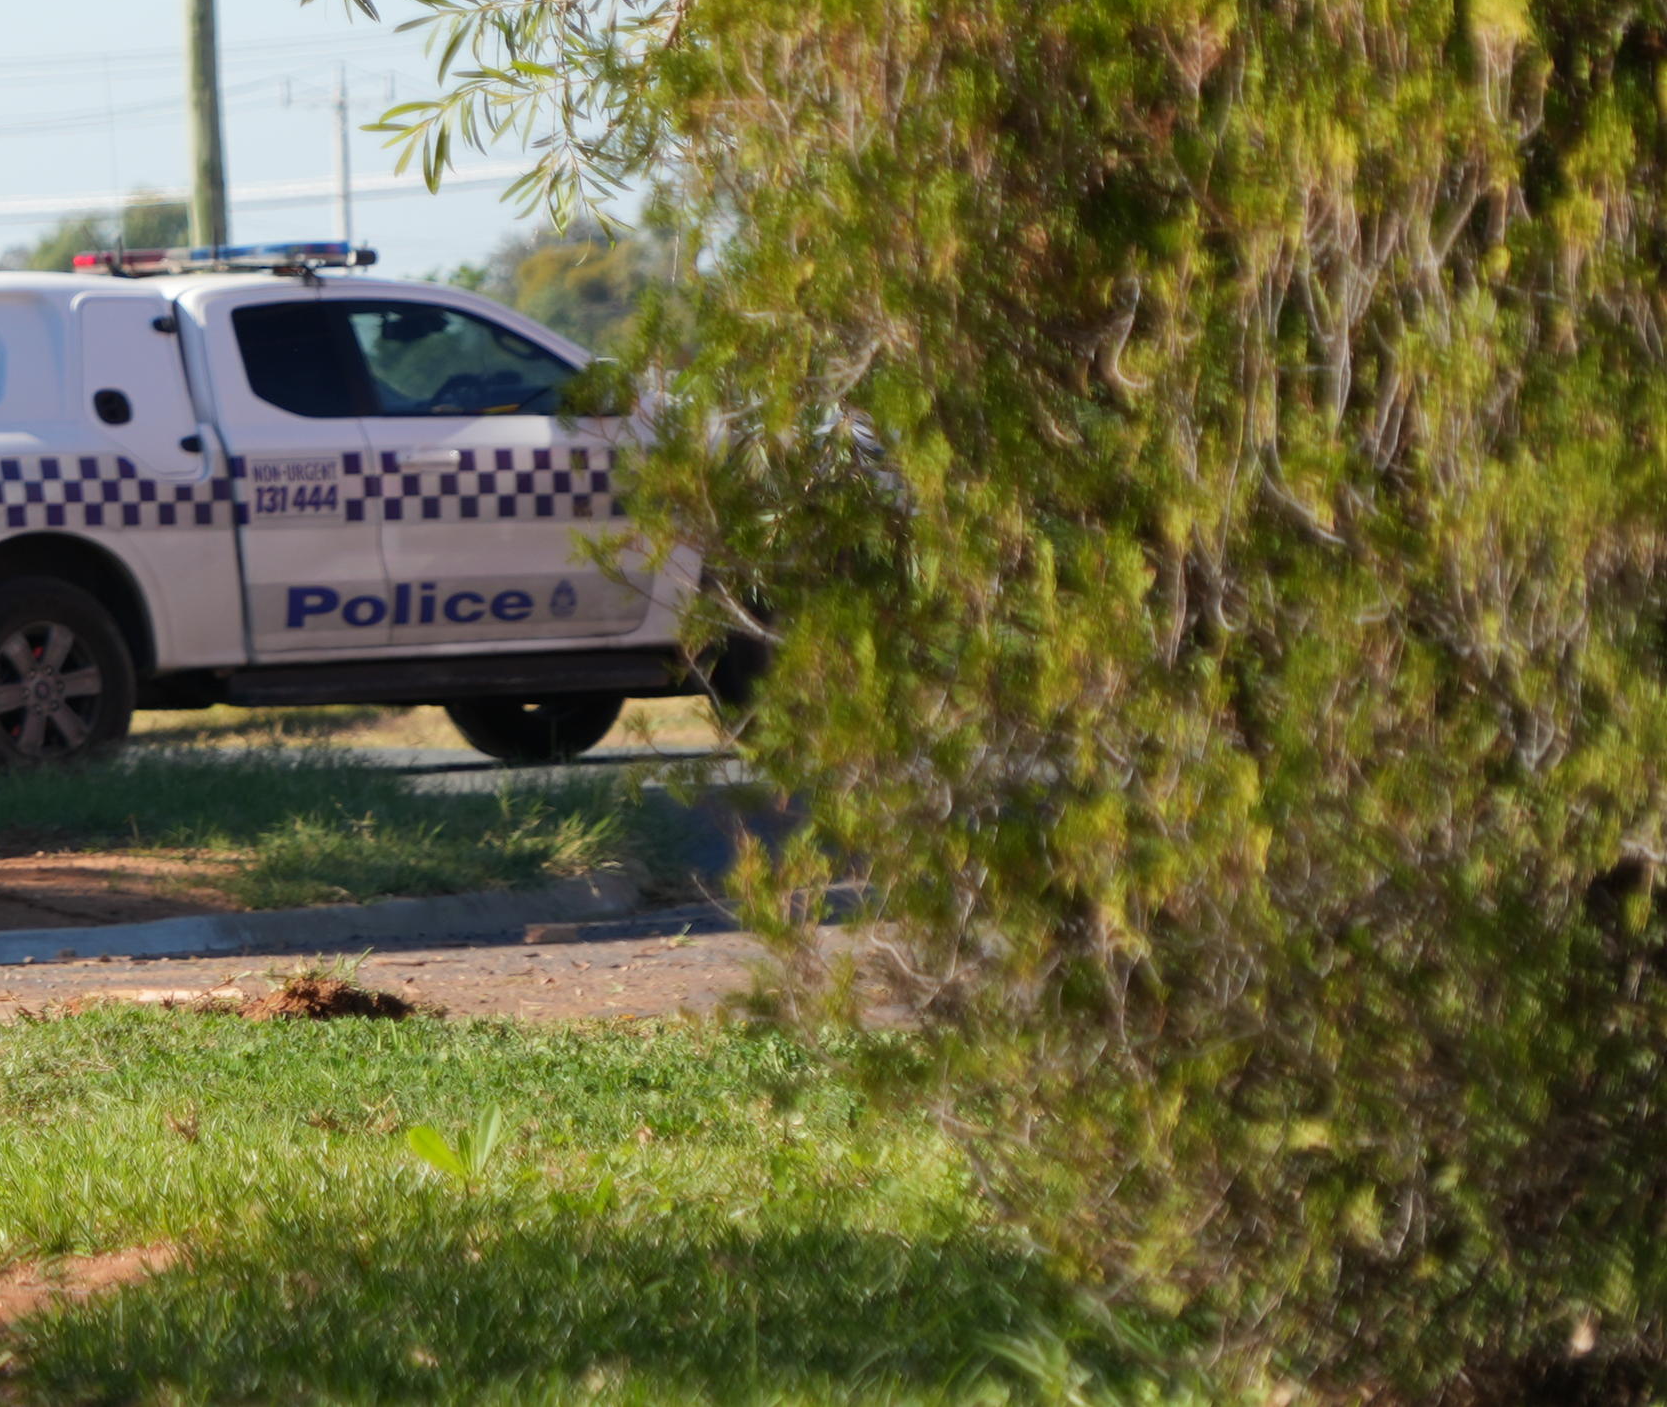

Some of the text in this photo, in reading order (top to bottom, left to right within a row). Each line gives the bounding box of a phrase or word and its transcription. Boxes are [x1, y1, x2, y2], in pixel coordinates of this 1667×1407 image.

[254, 461, 337, 483] NON-URGENT
[255, 484, 338, 513] 131 444
[285, 581, 534, 629] Police
